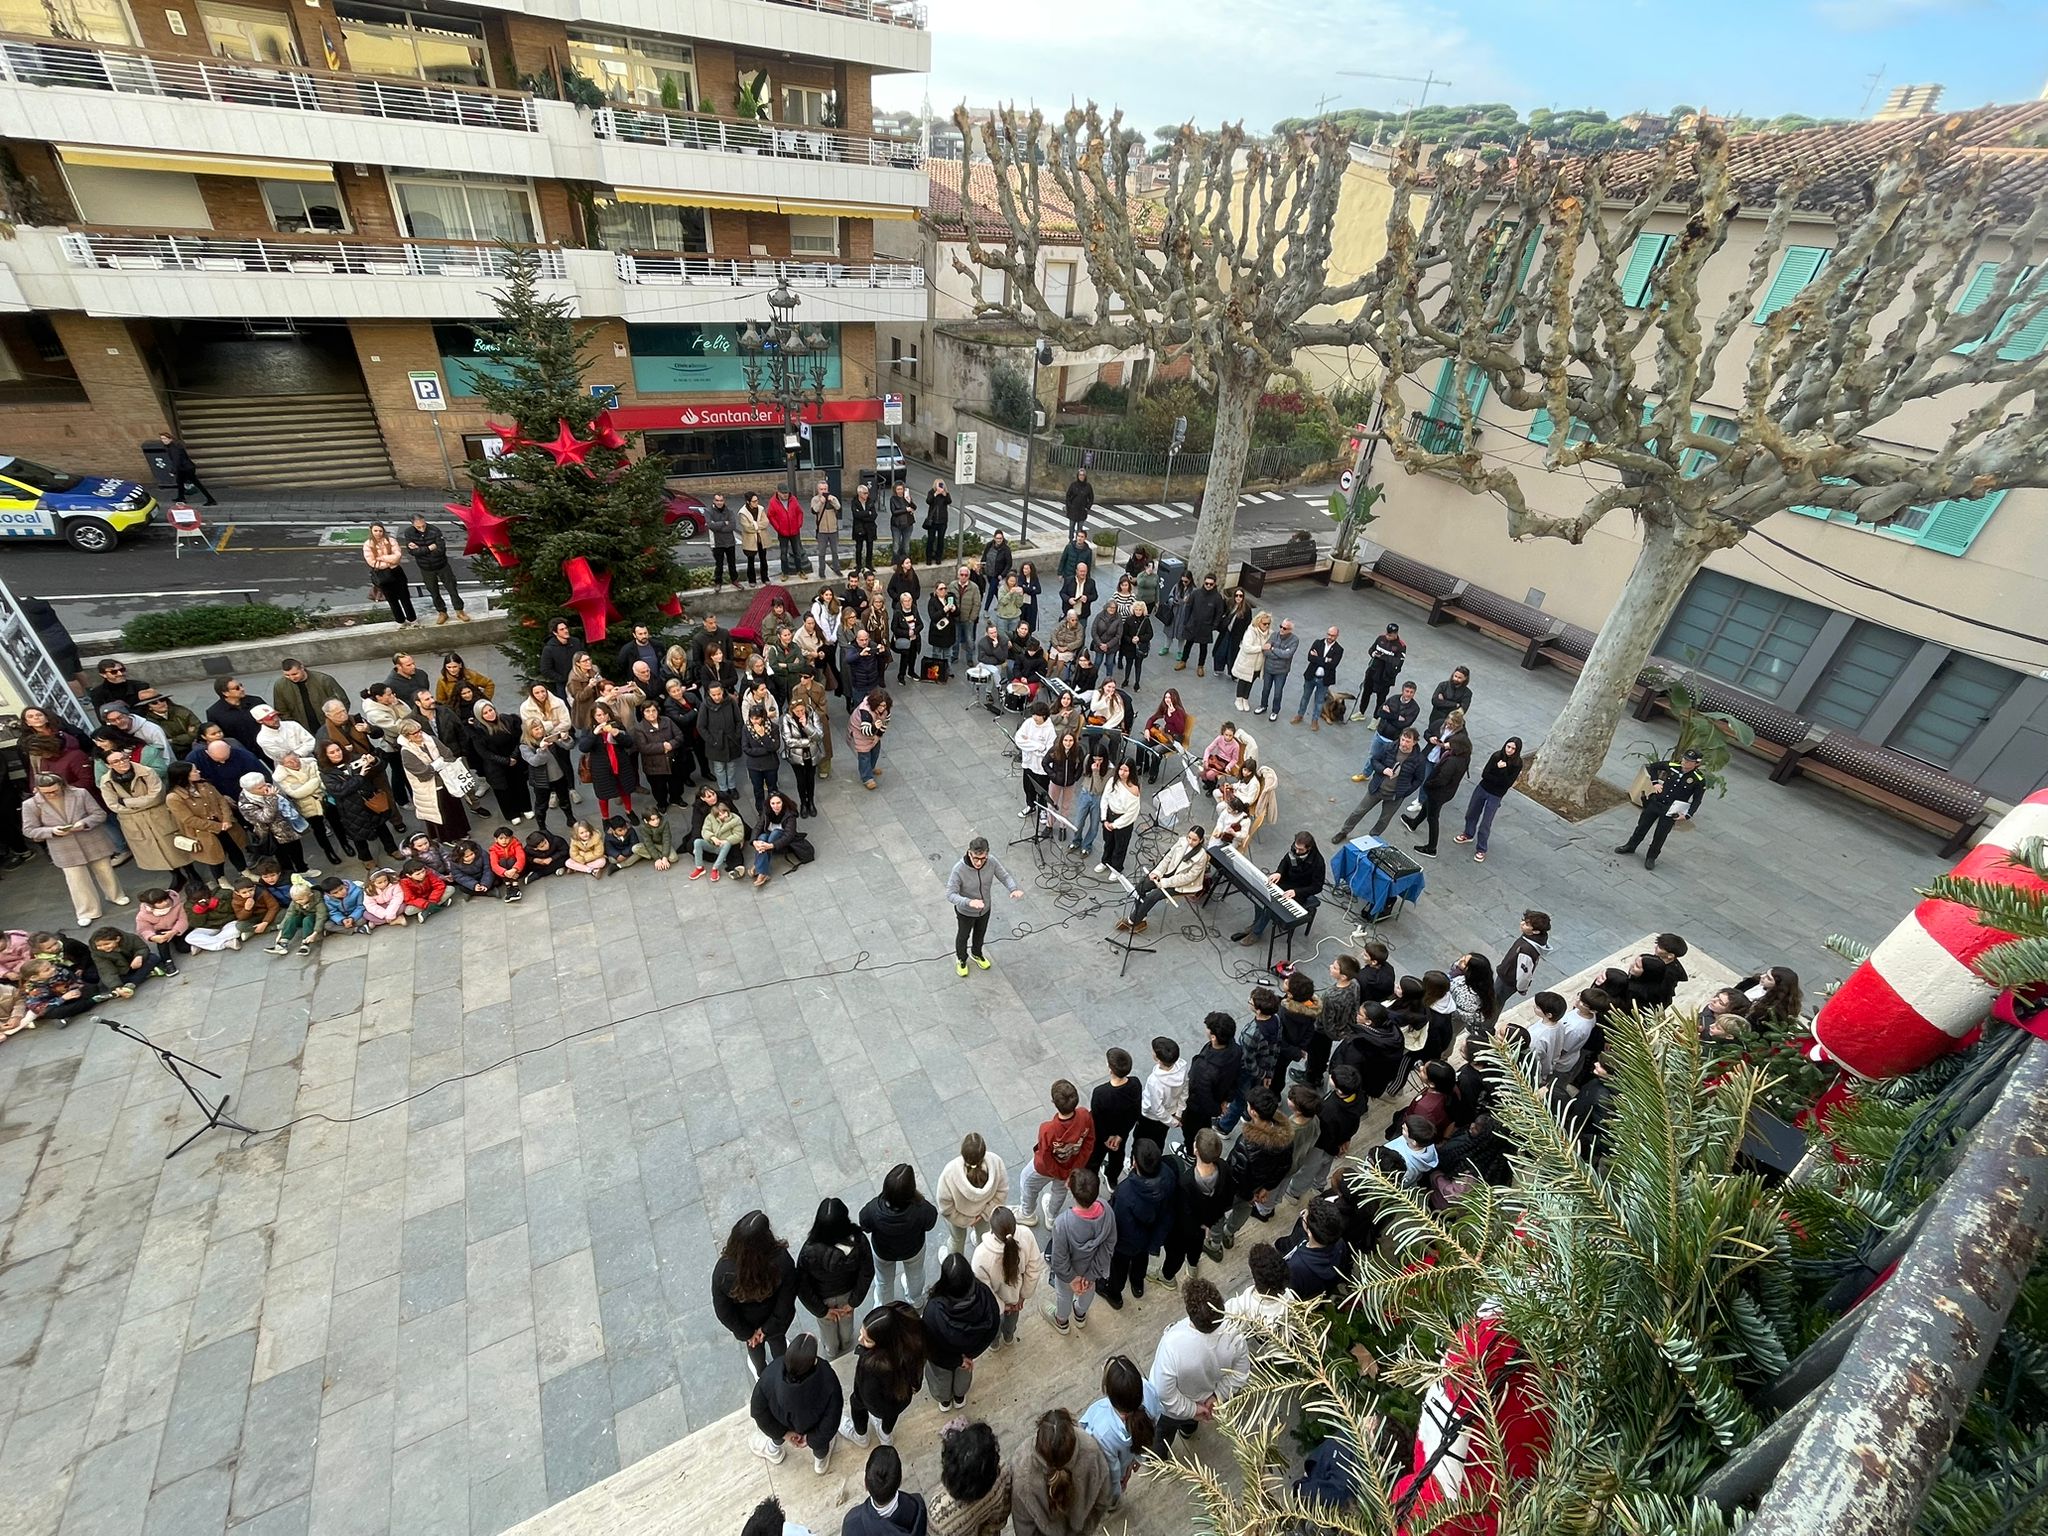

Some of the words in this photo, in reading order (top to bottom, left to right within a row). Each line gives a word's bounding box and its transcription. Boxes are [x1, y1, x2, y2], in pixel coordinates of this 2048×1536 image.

[691, 334, 731, 352] Feliç
[418, 381, 434, 398] P
[885, 394, 891, 403] P
[701, 409, 772, 423] Santander
[0, 511, 41, 523] ocal
